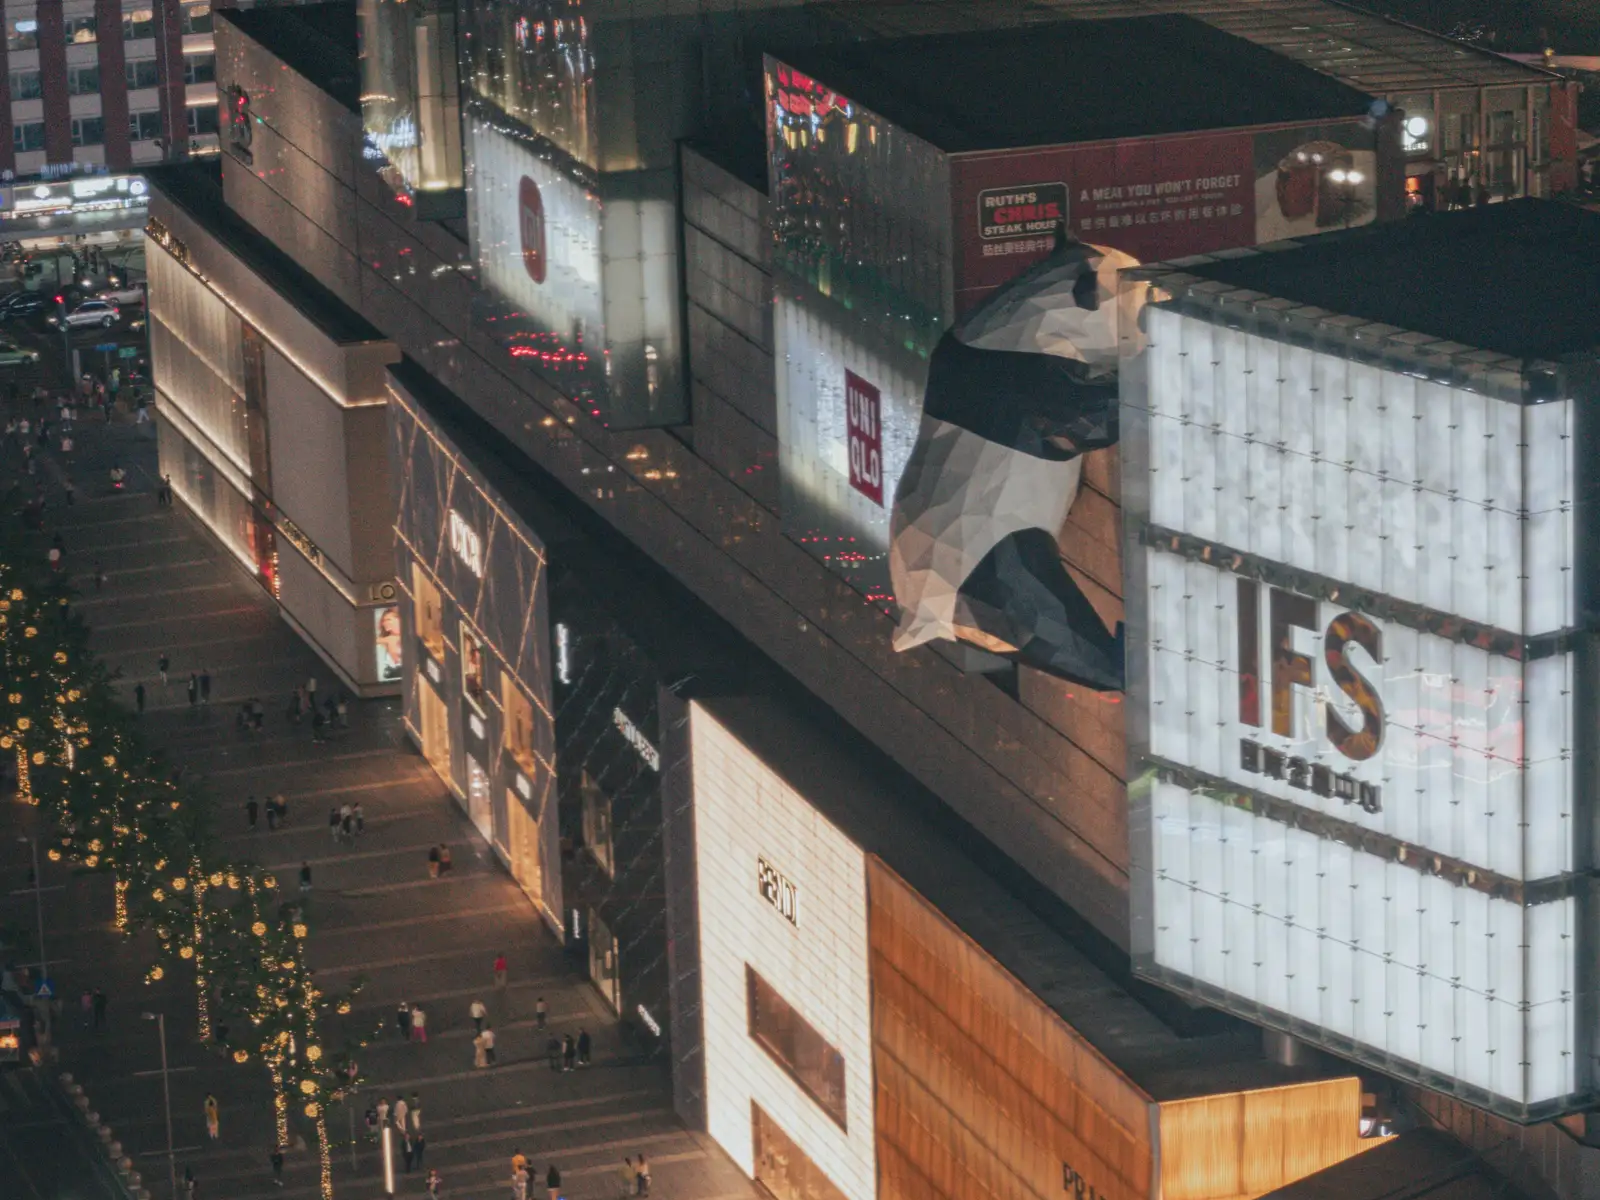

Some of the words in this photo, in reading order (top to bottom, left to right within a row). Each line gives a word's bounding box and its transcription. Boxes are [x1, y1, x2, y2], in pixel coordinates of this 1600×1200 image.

[985, 192, 1037, 208] RUTH'S
[1080, 190, 1089, 202] A
[1092, 187, 1123, 201] MEAL
[1128, 183, 1152, 197] YOU
[1154, 179, 1191, 196] WON'T
[1195, 174, 1241, 191] FORGET
[984, 224, 1022, 236] STEAK
[1026, 219, 1060, 231] HOUS
[993, 202, 1060, 225] CHRIS
[849, 386, 876, 440] UNI
[851, 435, 880, 487] QLO
[1236, 577, 1386, 761] IFS
[757, 856, 800, 930] FENDI
